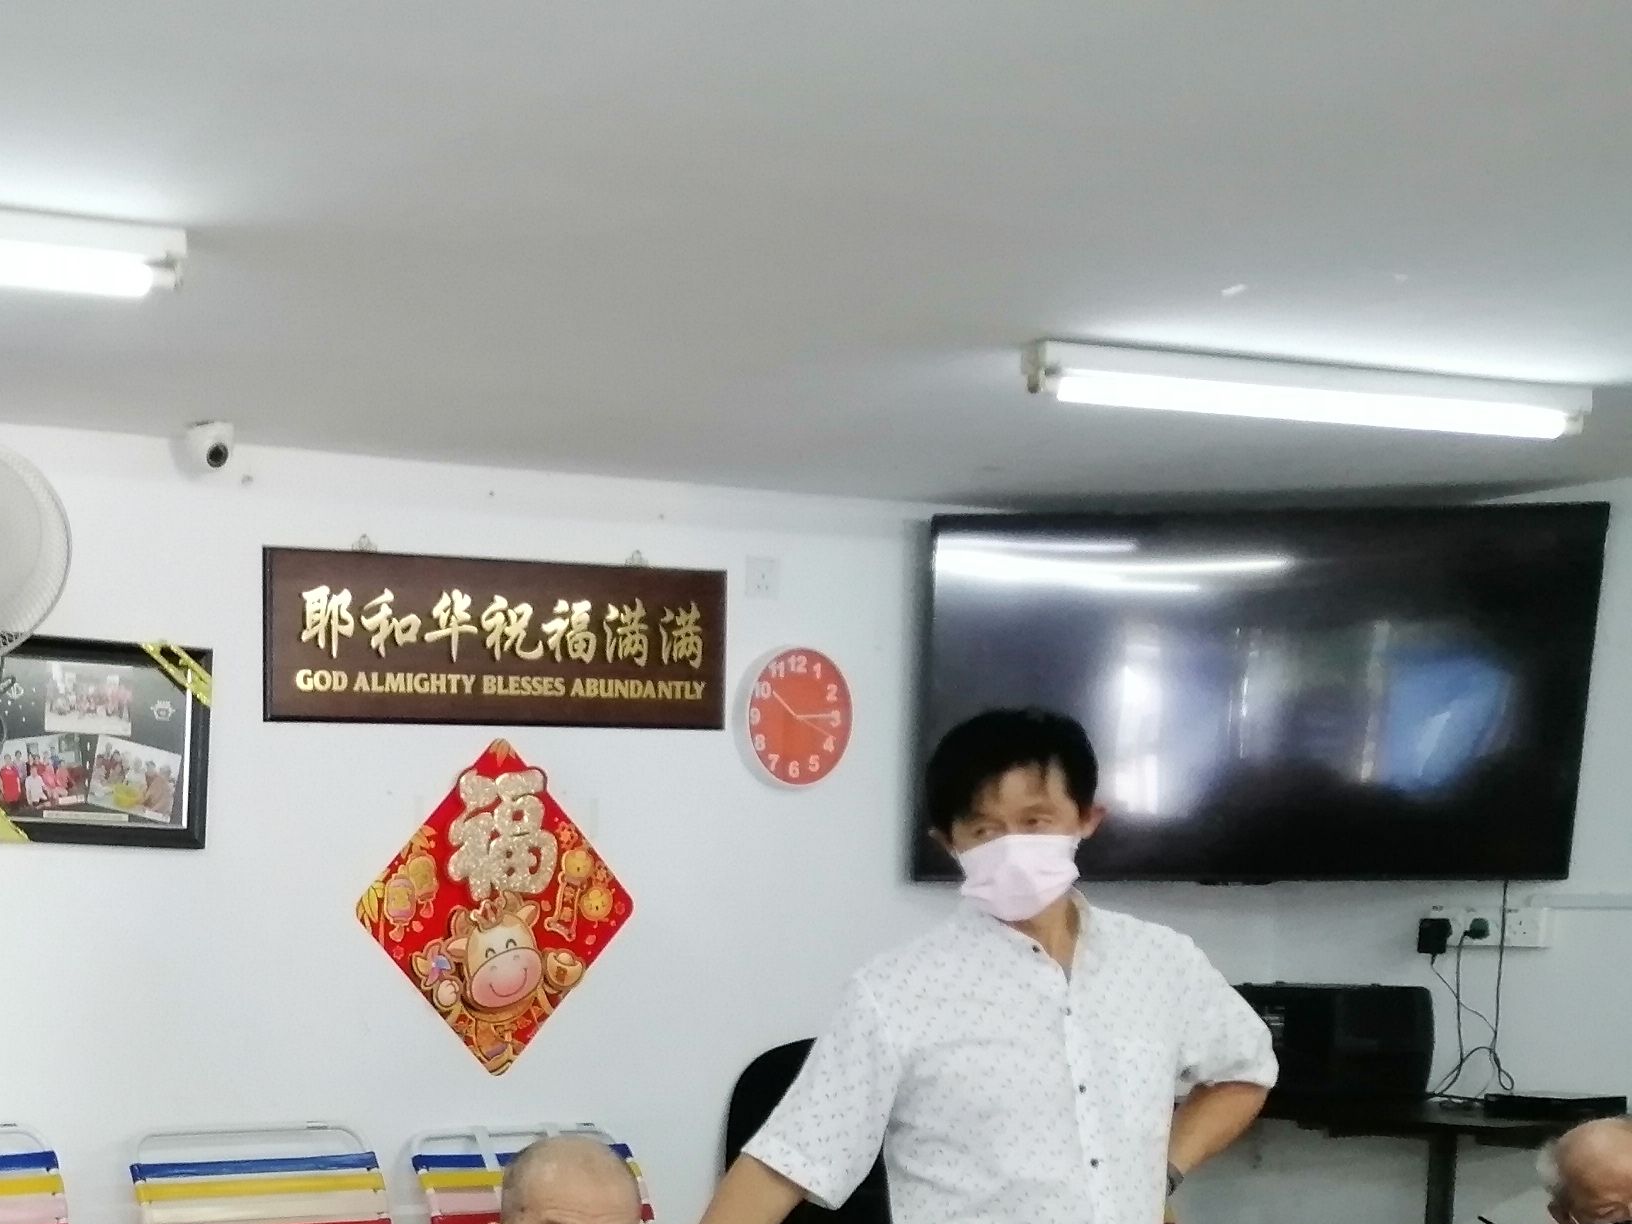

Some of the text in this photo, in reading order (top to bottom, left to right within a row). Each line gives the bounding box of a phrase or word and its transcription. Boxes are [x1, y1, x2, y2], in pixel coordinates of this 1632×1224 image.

[300, 584, 704, 669] 耶和华祝福满满
[769, 660, 786, 679] 11
[788, 655, 808, 673] 12
[812, 662, 822, 679] 1
[295, 669, 707, 701] GOD ALMIGHTY BLESSES ABUNDANTLY
[754, 680, 772, 700] 10
[825, 683, 839, 702] 2
[750, 707, 761, 726] 9
[829, 709, 842, 728] 3
[753, 734, 766, 751] 8
[823, 735, 836, 753] 4
[768, 753, 781, 772] 7
[788, 760, 801, 778] 6
[808, 754, 821, 773] 5
